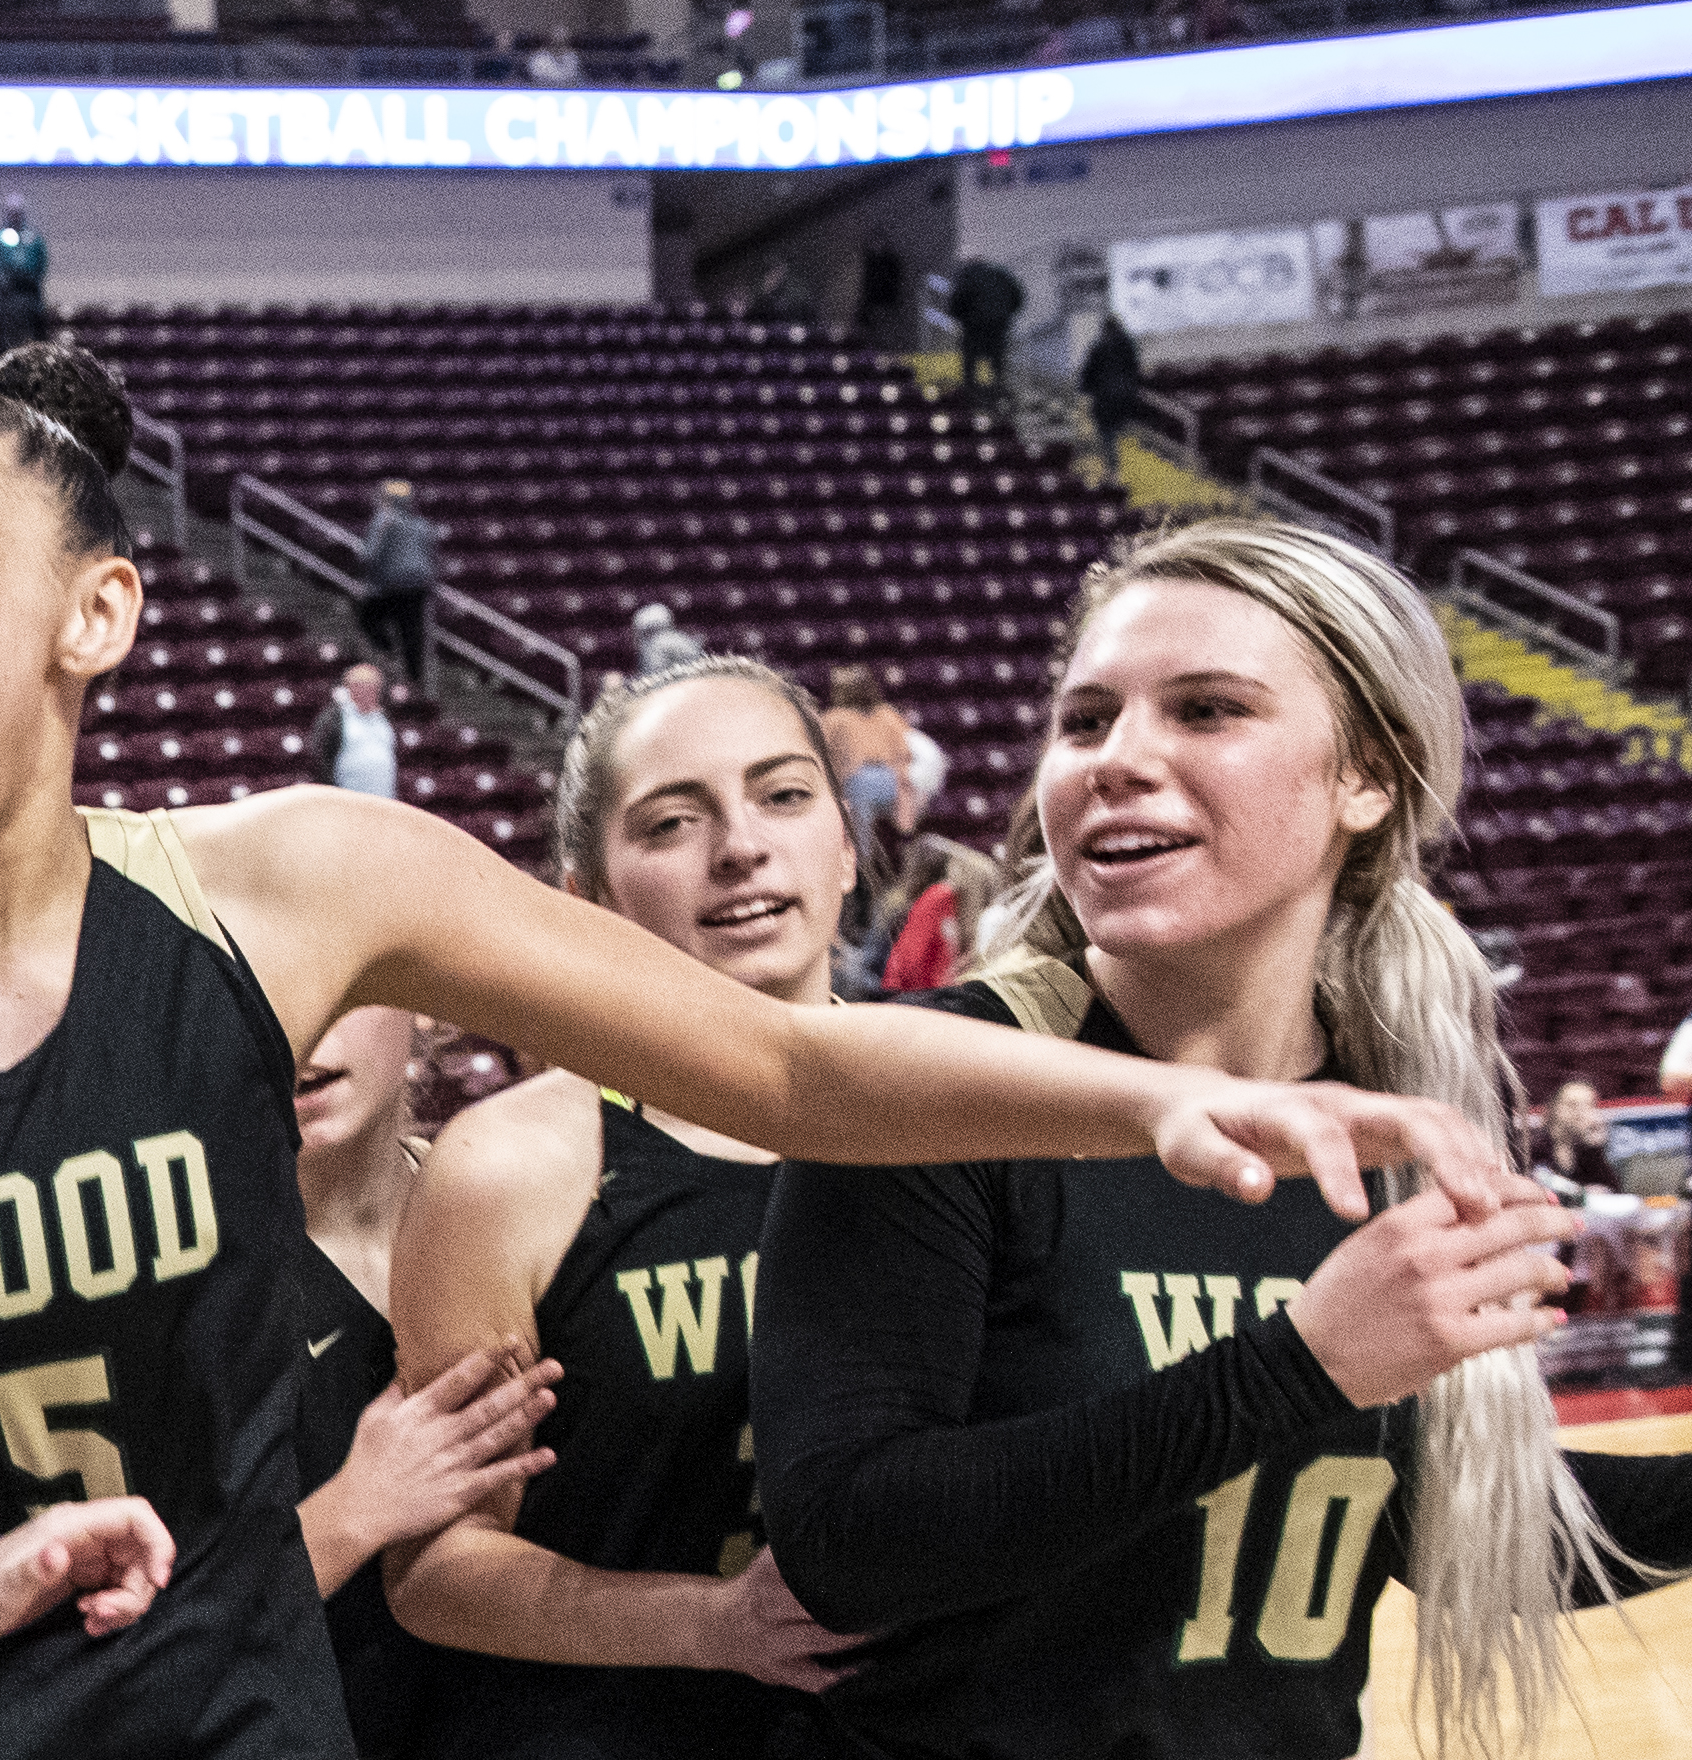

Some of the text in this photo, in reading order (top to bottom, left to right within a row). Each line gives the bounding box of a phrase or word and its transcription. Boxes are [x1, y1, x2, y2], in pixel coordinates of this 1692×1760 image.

[484, 72, 1075, 169] CHAMPIONSHIP
[1566, 200, 1668, 242] CAL
[1175, 1454, 1400, 1662] 10
